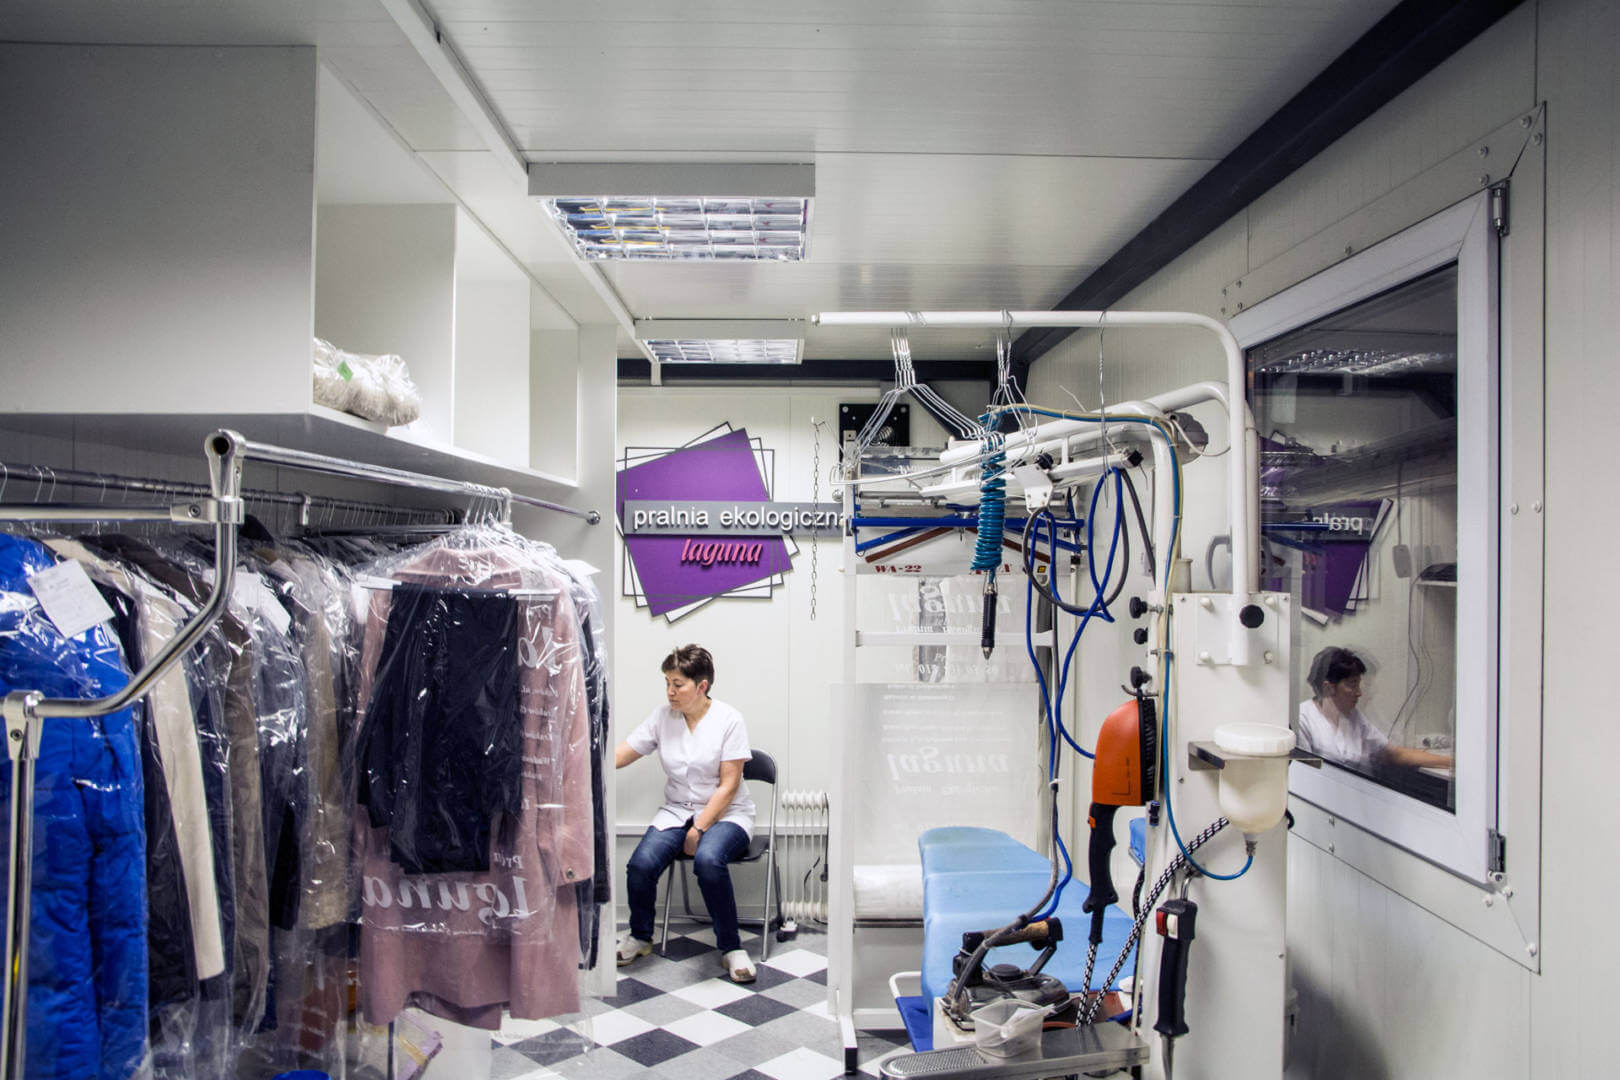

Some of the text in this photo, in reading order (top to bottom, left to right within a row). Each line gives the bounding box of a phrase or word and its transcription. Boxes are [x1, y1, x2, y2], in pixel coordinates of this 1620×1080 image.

[633, 507, 844, 530] pralnia ekologiczn
[681, 539, 762, 565] laguna
[874, 564, 922, 574] WA-22
